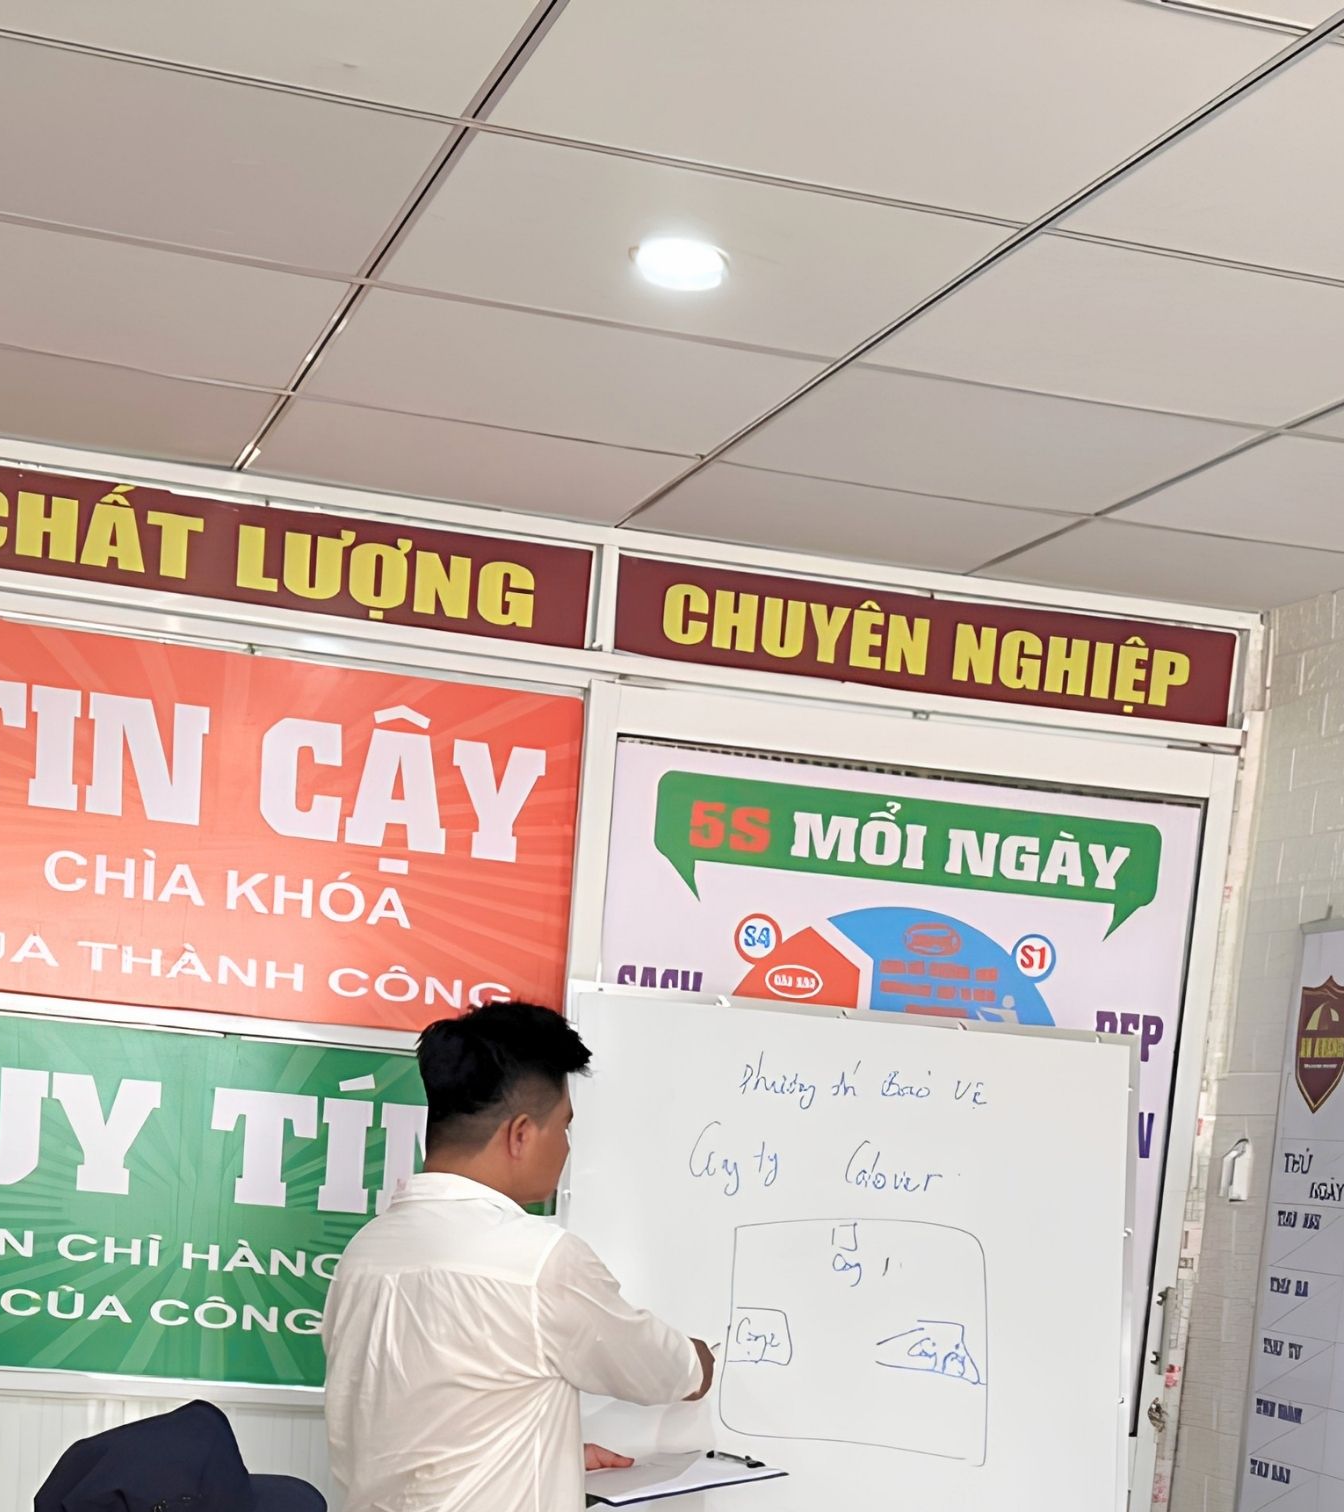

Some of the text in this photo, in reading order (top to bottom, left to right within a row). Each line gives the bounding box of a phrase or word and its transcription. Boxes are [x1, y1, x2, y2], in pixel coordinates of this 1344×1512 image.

[236, 525, 536, 629] LƯỢNG
[662, 583, 1190, 712] CHUYÊN NGHIỆP
[259, 704, 546, 874] CẬY
[44, 848, 411, 929] CHÌA KHÓA
[689, 799, 771, 853] 5S
[946, 830, 1131, 891] NGÀY
[78, 940, 304, 993] THÀNH
[328, 965, 512, 1009] CÔNG
[0, 1285, 322, 1335] CỦA CÔNG
